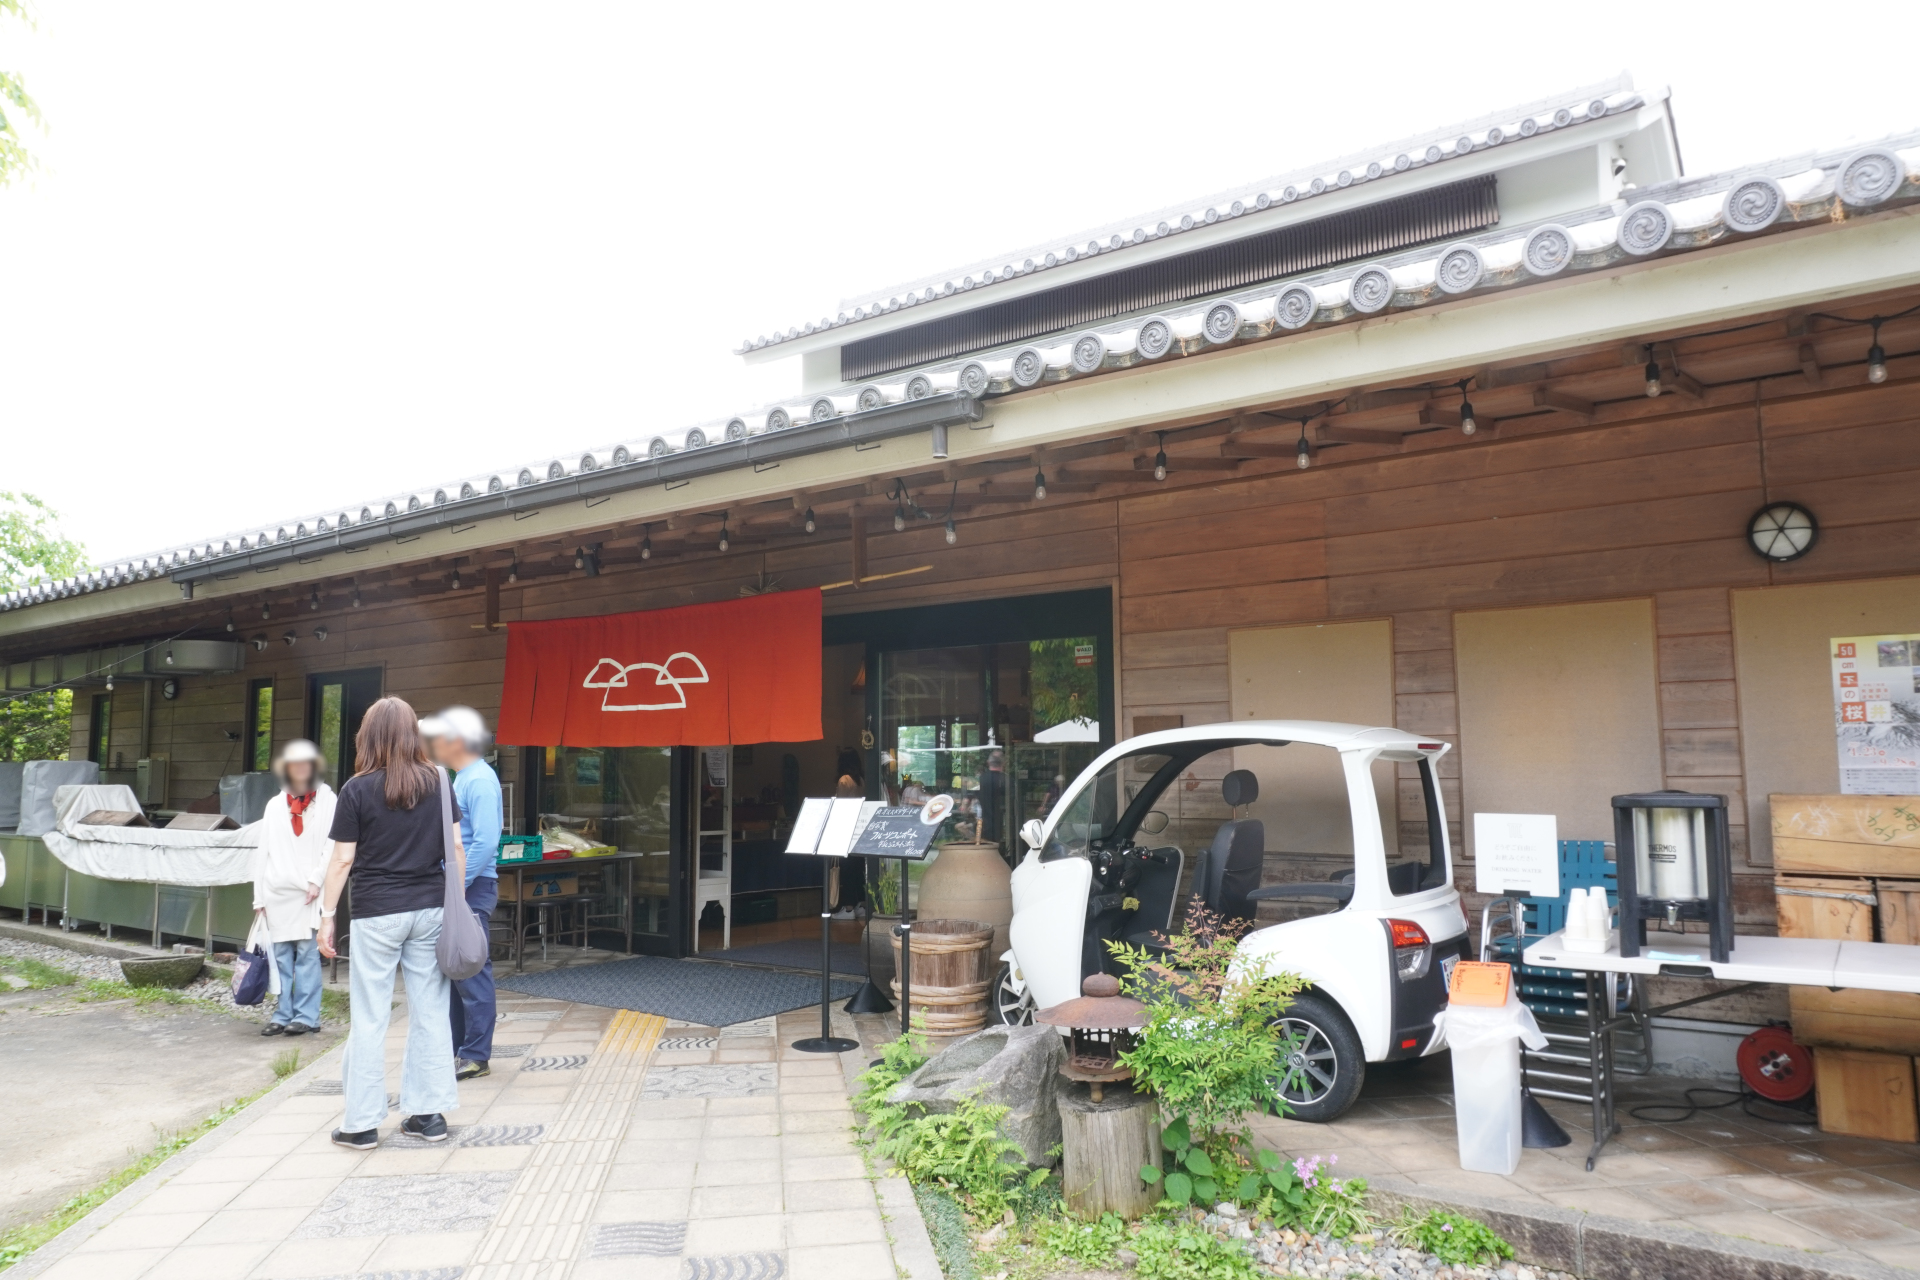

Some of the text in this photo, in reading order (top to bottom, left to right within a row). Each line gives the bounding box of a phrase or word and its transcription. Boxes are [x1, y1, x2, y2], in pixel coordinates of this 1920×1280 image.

[1494, 843, 1537, 852] どうぞご自由に
[1648, 844, 1676, 852] THERMOS
[1495, 854, 1538, 862] お飲みください
